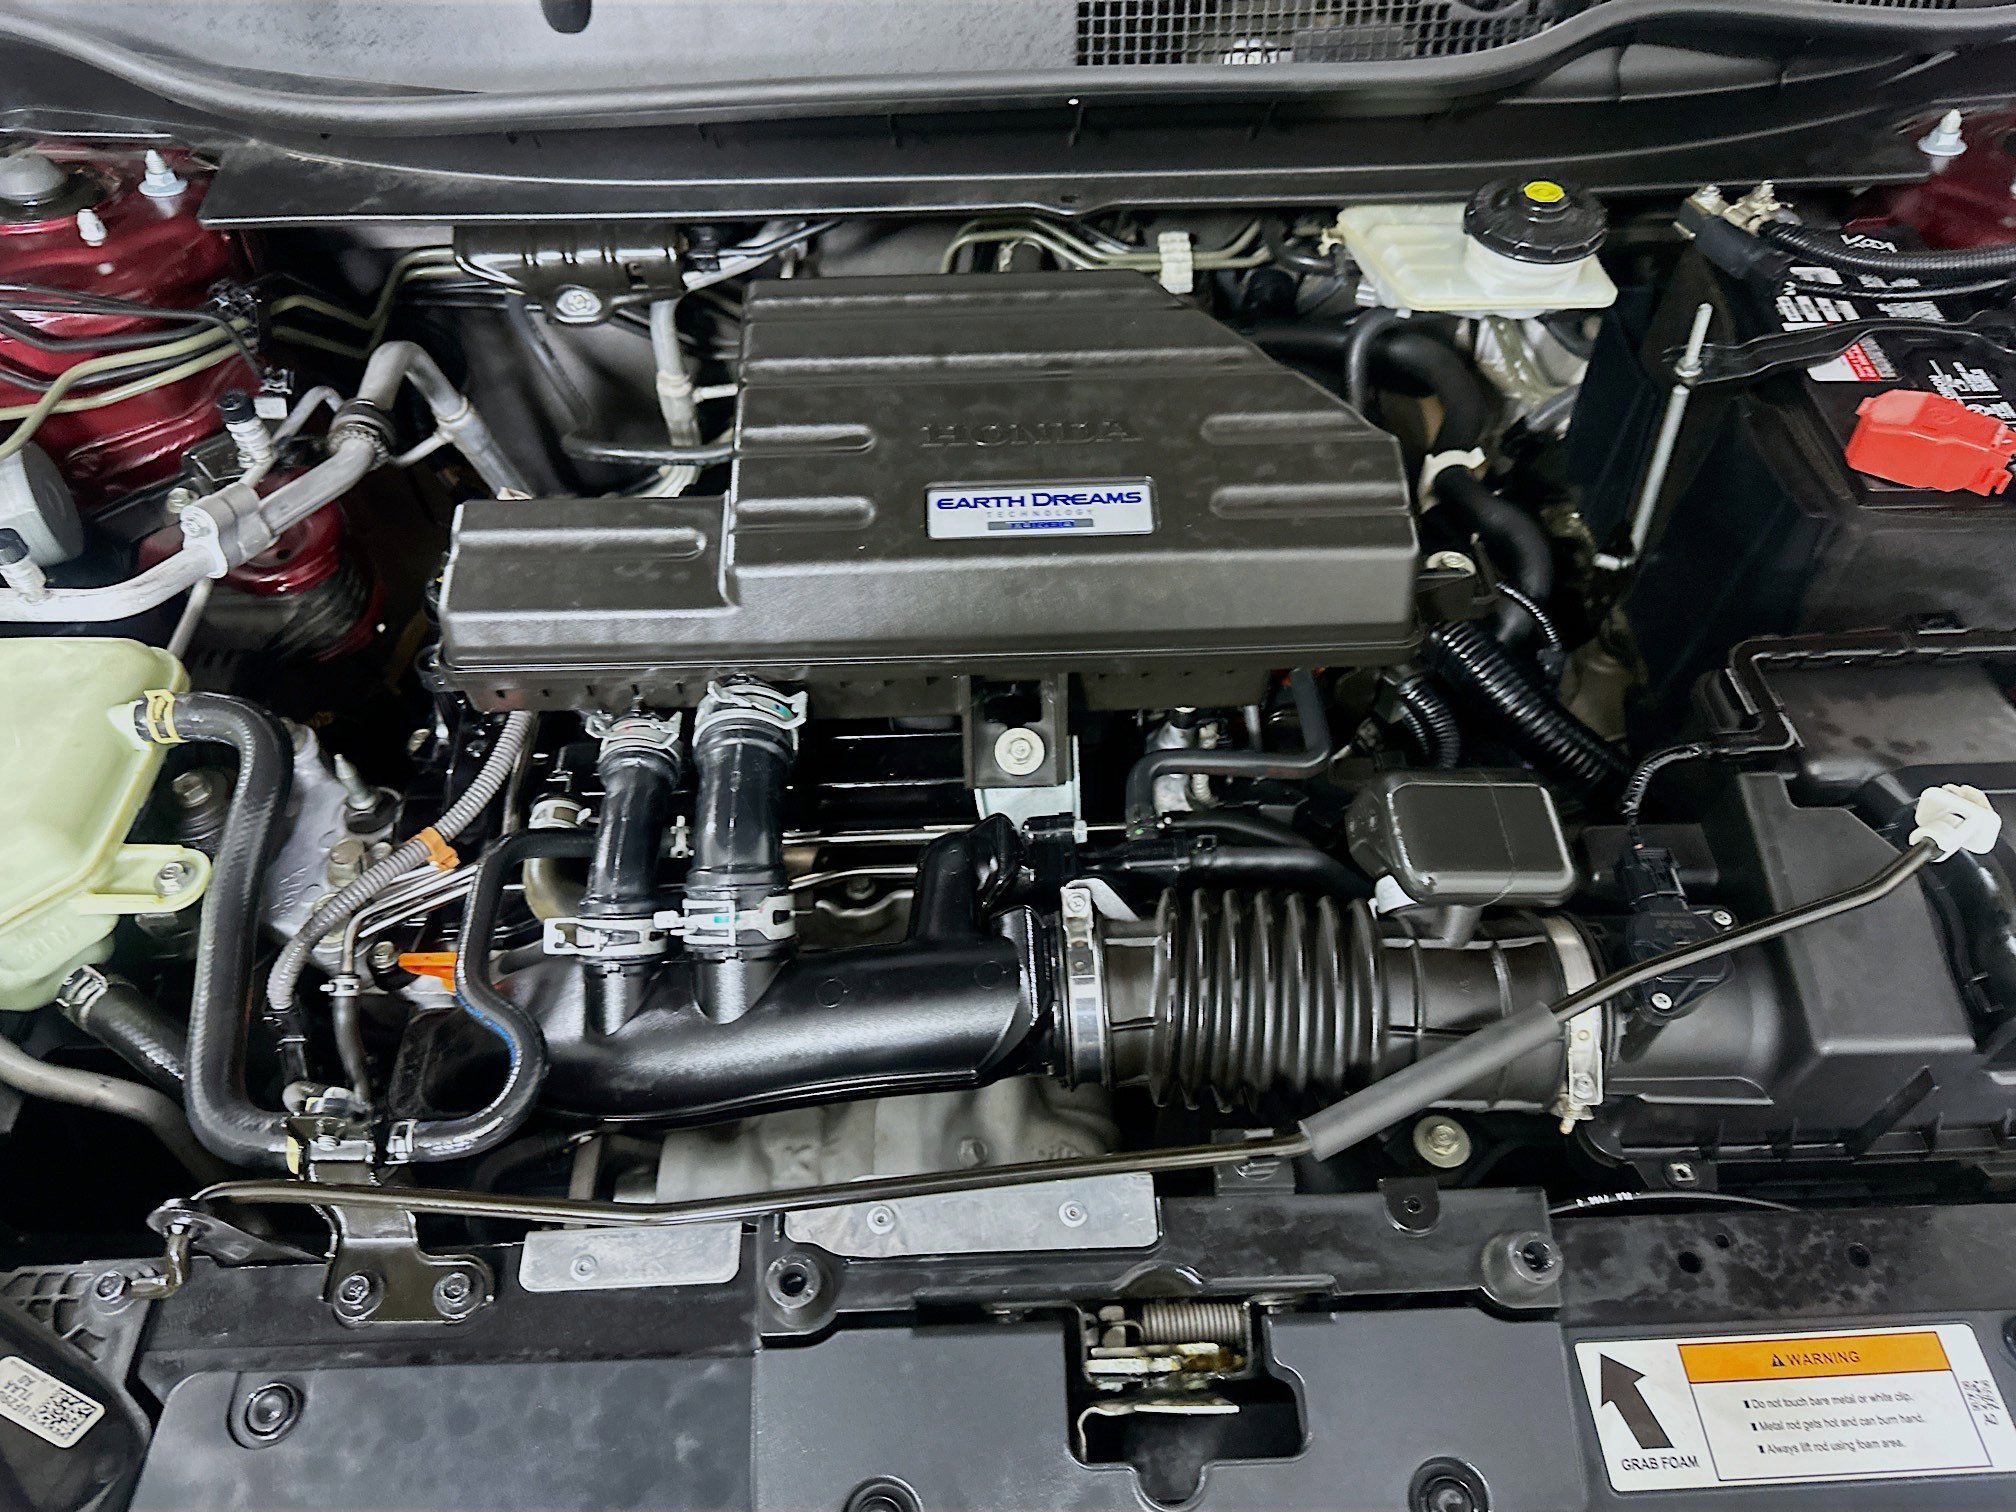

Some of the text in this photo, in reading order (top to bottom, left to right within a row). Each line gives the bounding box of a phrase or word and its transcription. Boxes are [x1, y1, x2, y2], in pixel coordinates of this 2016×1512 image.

[920, 420, 1144, 447] HONDA
[937, 491, 1142, 510] EARTH DREAMS
[987, 508, 1094, 519] TECHNOLOGY
[1787, 1351, 1860, 1366] WARNING
[1751, 1399, 1766, 1409] Do
[1767, 1398, 1782, 1408] not
[1783, 1398, 1808, 1407] touch
[1831, 1393, 1856, 1404] metal
[1857, 1395, 1867, 1404] or
[1868, 1392, 1892, 1402] white
[1758, 1420, 1784, 1431] Metal
[1785, 1419, 1801, 1430] rod
[1802, 1419, 1822, 1432] gets
[1822, 1417, 1840, 1428] hot
[1840, 1416, 1858, 1427] and
[1859, 1417, 1876, 1426] can
[1876, 1414, 1899, 1425] burn
[1766, 1442, 1799, 1455] Always
[1813, 1440, 1830, 1451] rod
[1830, 1440, 1856, 1452] using
[1621, 1455, 1700, 1471] GRAB FOAM
